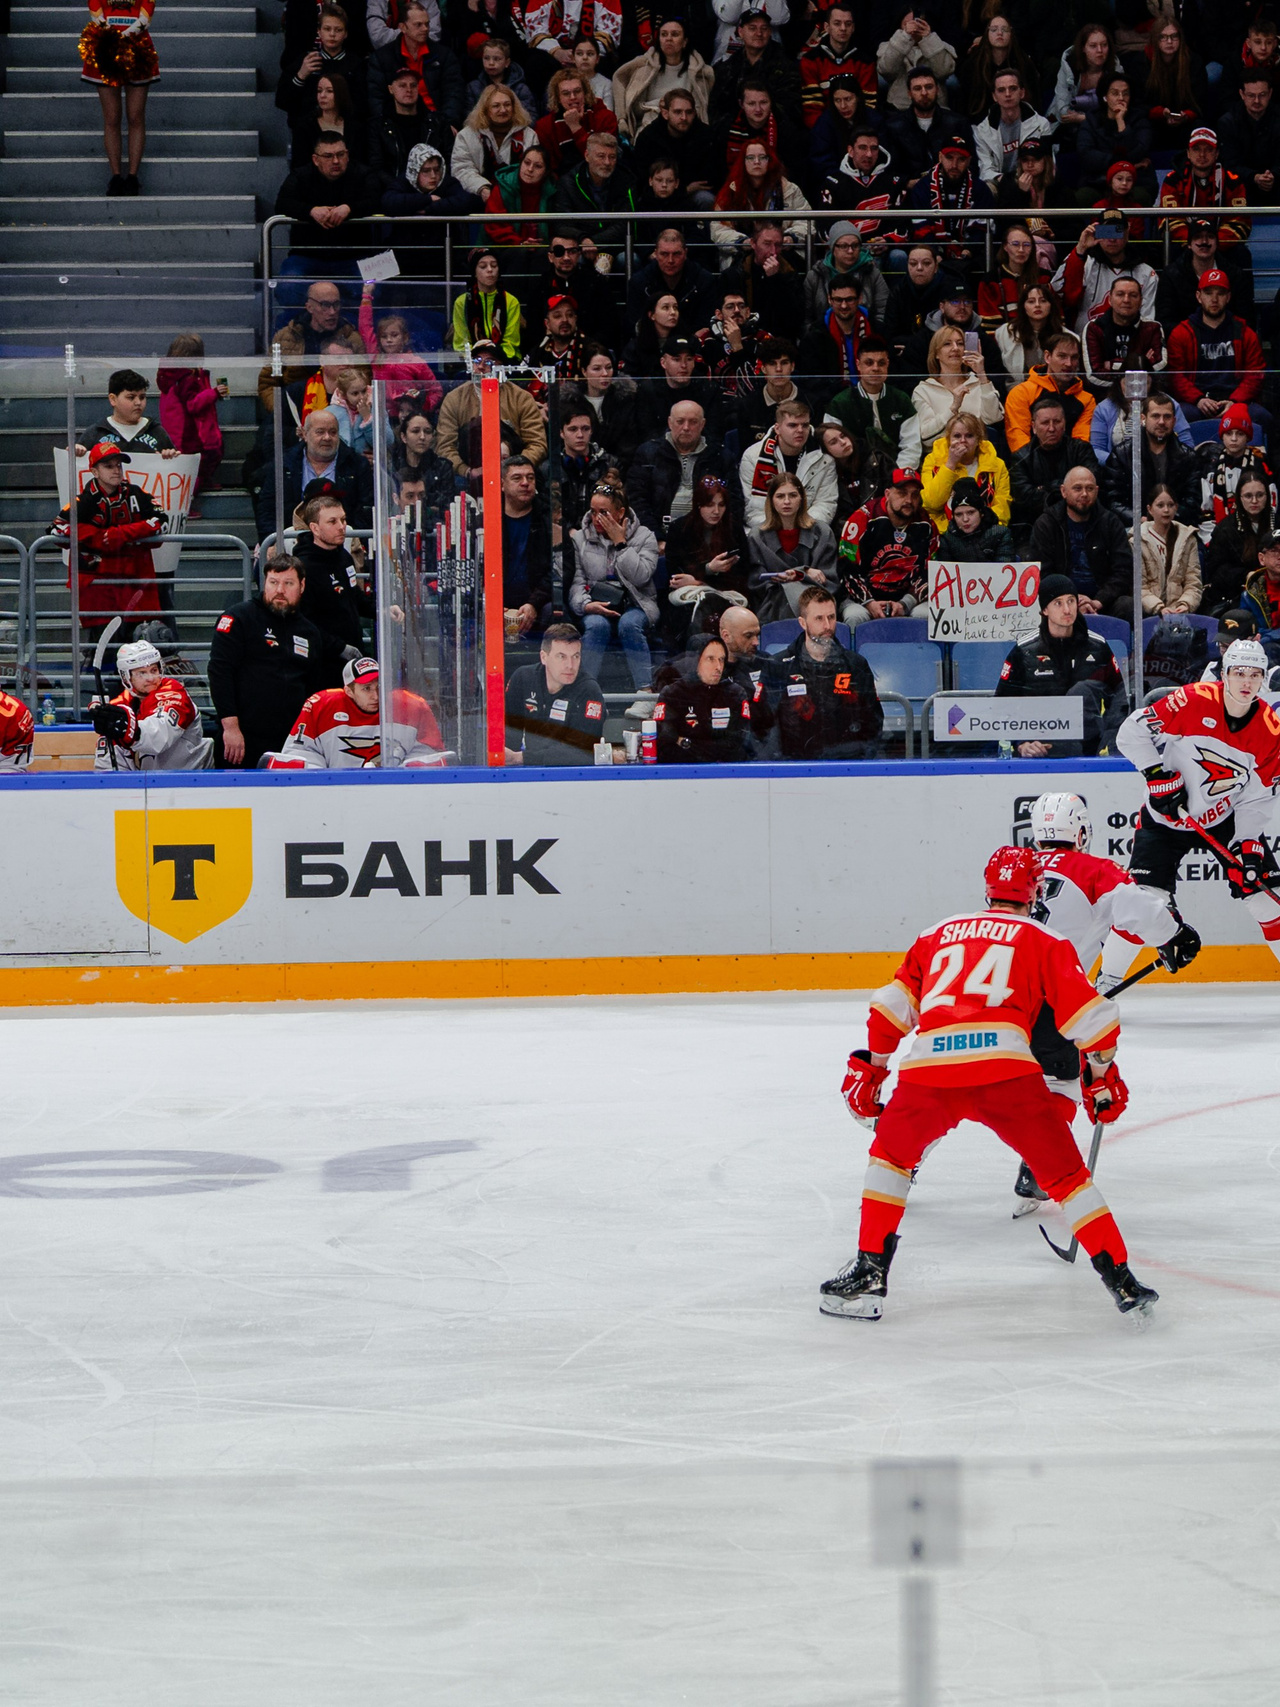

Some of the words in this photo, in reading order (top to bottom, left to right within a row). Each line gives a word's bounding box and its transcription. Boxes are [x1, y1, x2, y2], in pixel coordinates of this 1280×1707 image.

[930, 606, 962, 639] You
[964, 610, 988, 626] have
[964, 626, 987, 640] have
[991, 626, 1005, 639] to
[969, 717, 1071, 731] Ростелеком
[1043, 827, 1056, 840] 13
[284, 838, 561, 899] БАНК
[940, 919, 1022, 945] SHAROV
[920, 943, 1016, 1016] 24
[932, 1031, 999, 1053] SIBUR
